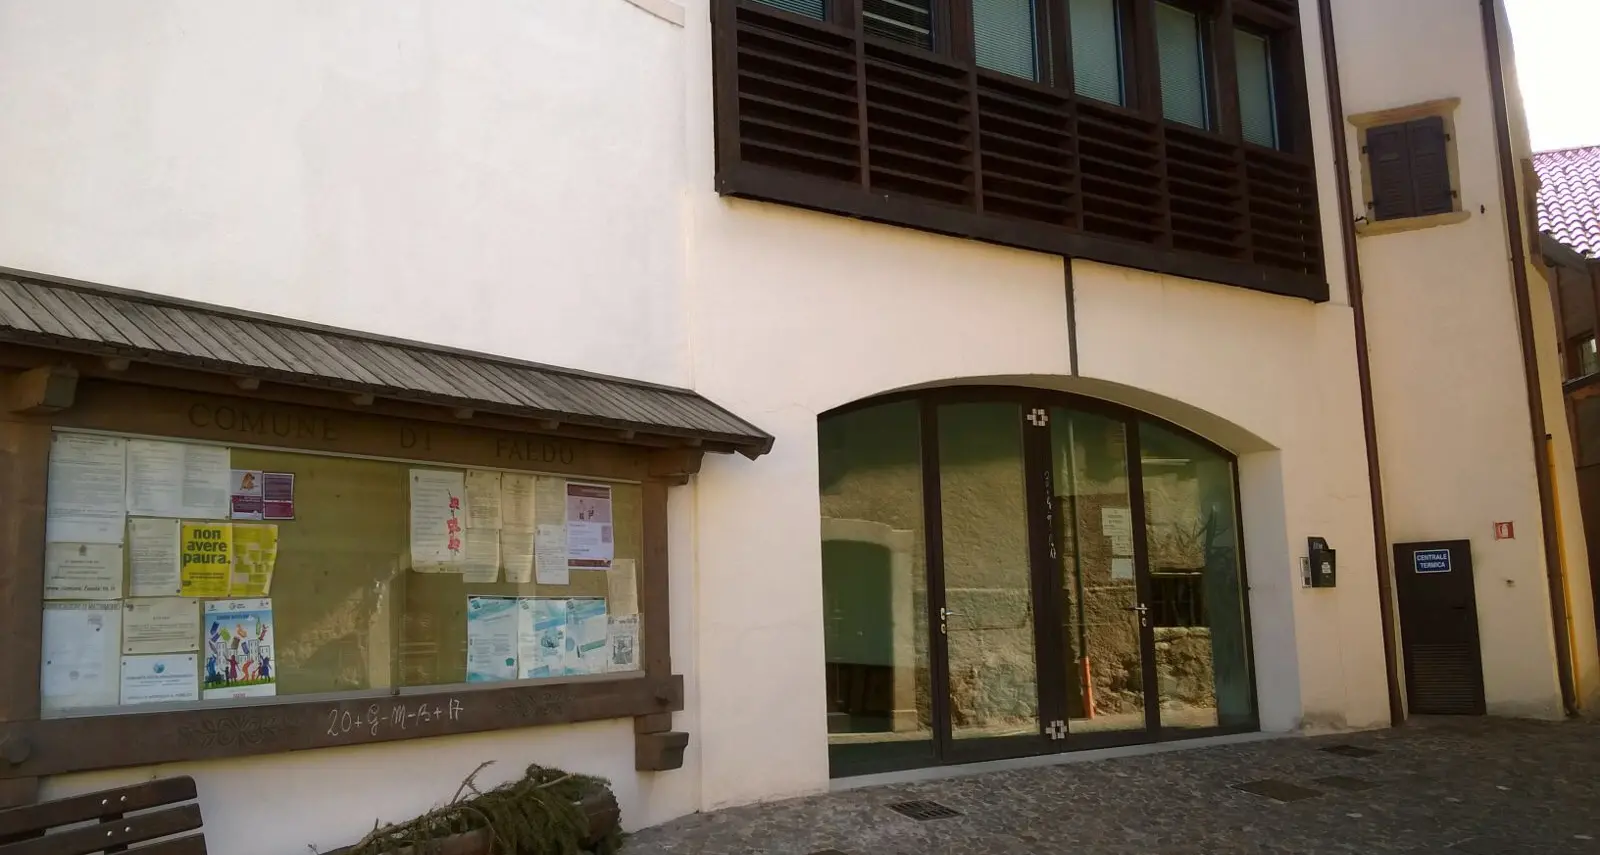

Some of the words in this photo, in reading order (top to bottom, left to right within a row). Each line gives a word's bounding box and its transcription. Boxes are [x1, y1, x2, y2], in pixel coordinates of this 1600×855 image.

[188, 403, 339, 442] COMUNE
[399, 425, 432, 451] DI
[193, 529, 221, 540] non
[187, 540, 227, 552] avere
[183, 552, 231, 568] paura.
